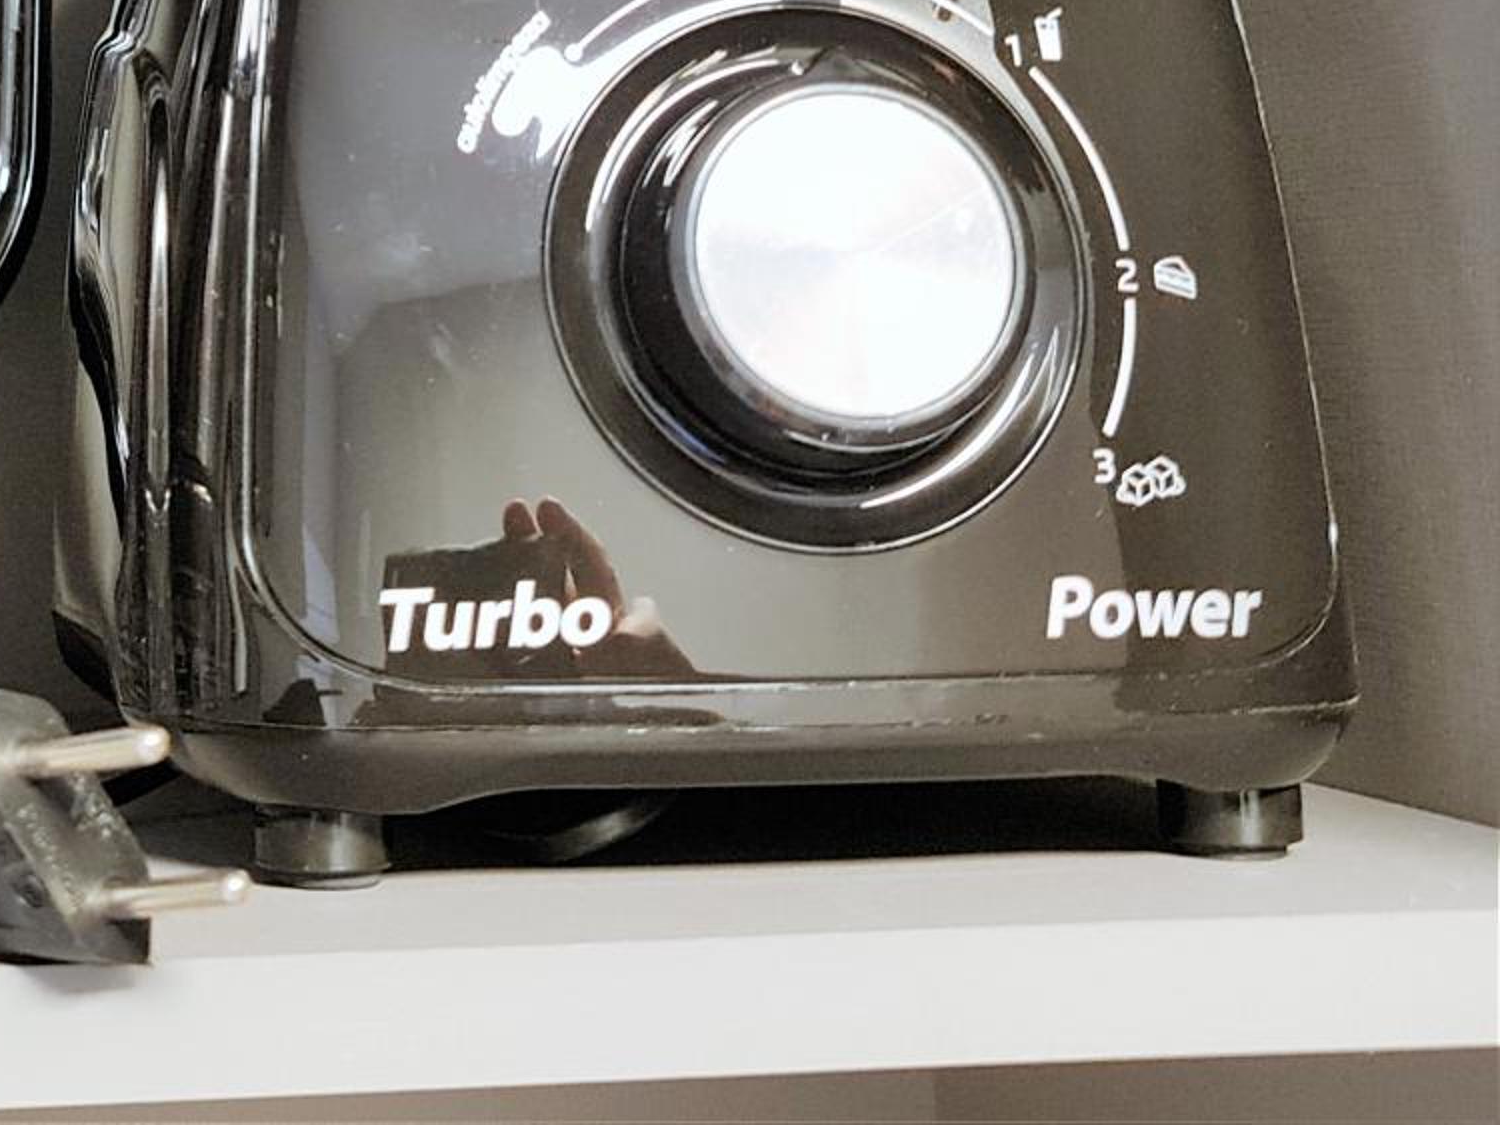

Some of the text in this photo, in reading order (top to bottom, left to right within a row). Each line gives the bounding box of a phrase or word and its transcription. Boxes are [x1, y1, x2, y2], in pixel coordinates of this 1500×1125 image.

[1004, 32, 1022, 67] 1
[1115, 258, 1140, 292] 2
[1092, 448, 1117, 483] 3
[379, 578, 613, 653] Turbo
[1046, 574, 1263, 640] Power
